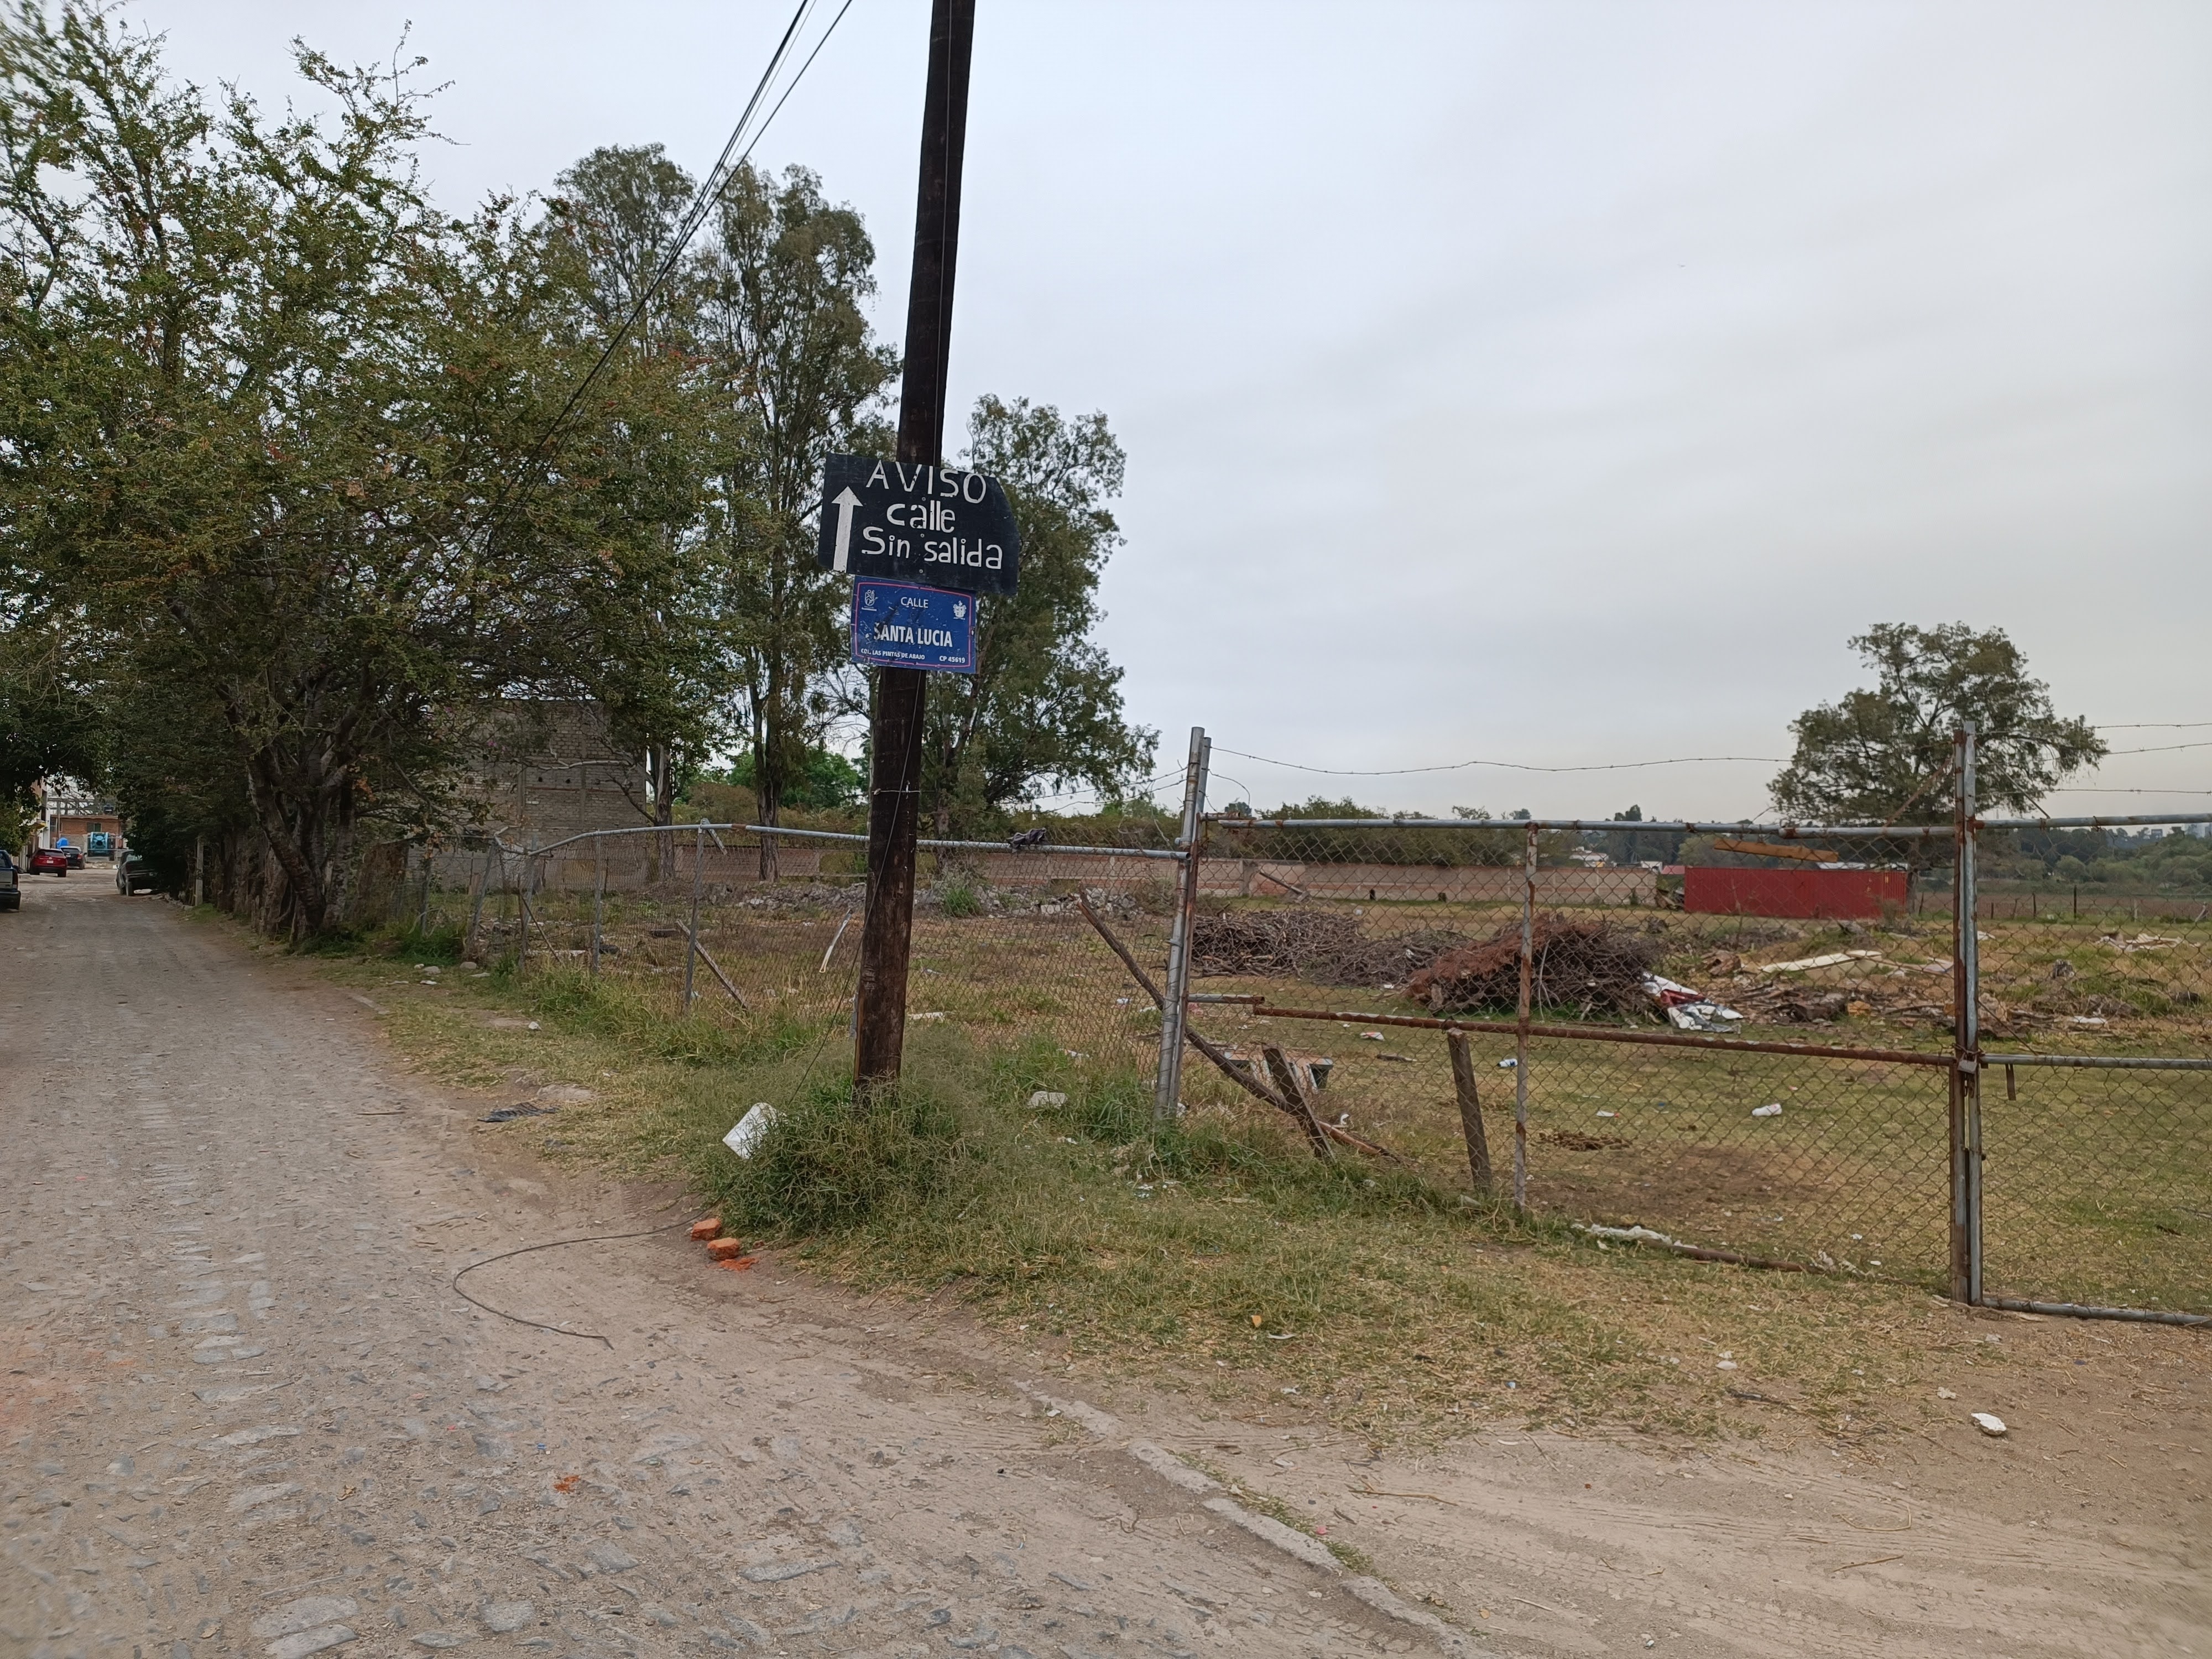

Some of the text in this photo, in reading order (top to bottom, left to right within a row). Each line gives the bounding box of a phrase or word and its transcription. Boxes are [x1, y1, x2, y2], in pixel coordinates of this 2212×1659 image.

[866, 460, 986, 504] AVISO
[862, 526, 1003, 570] Sin salida
[900, 596, 929, 608] CALLE
[873, 622, 953, 648] SANTA LUCIA
